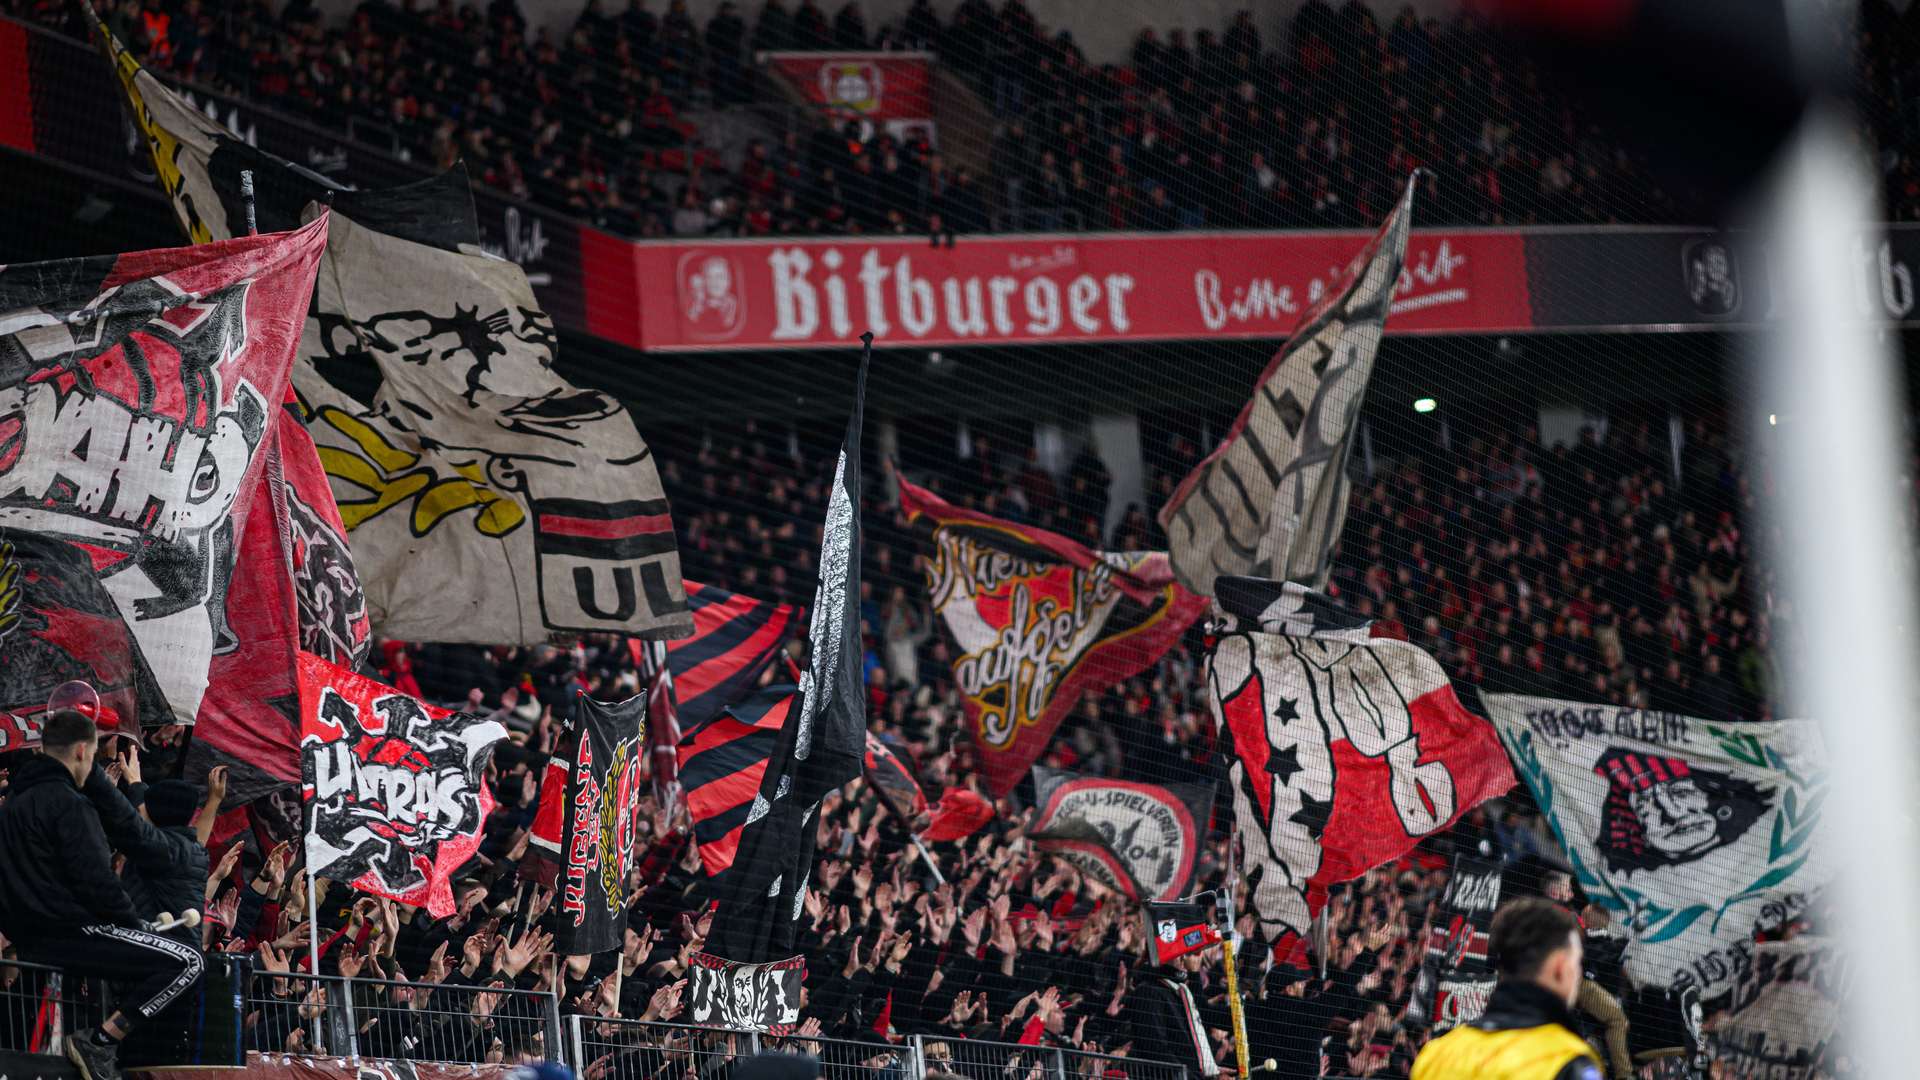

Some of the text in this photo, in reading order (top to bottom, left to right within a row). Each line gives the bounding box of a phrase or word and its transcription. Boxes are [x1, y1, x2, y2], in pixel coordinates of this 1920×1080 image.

[768, 246, 1135, 341] Bitburger
[1195, 268, 1300, 331] Bitte
[572, 561, 689, 622] UL
[314, 742, 471, 830] ULTRAS
[563, 728, 592, 927] JUGEND
[142, 987, 177, 1017] PITBULL
